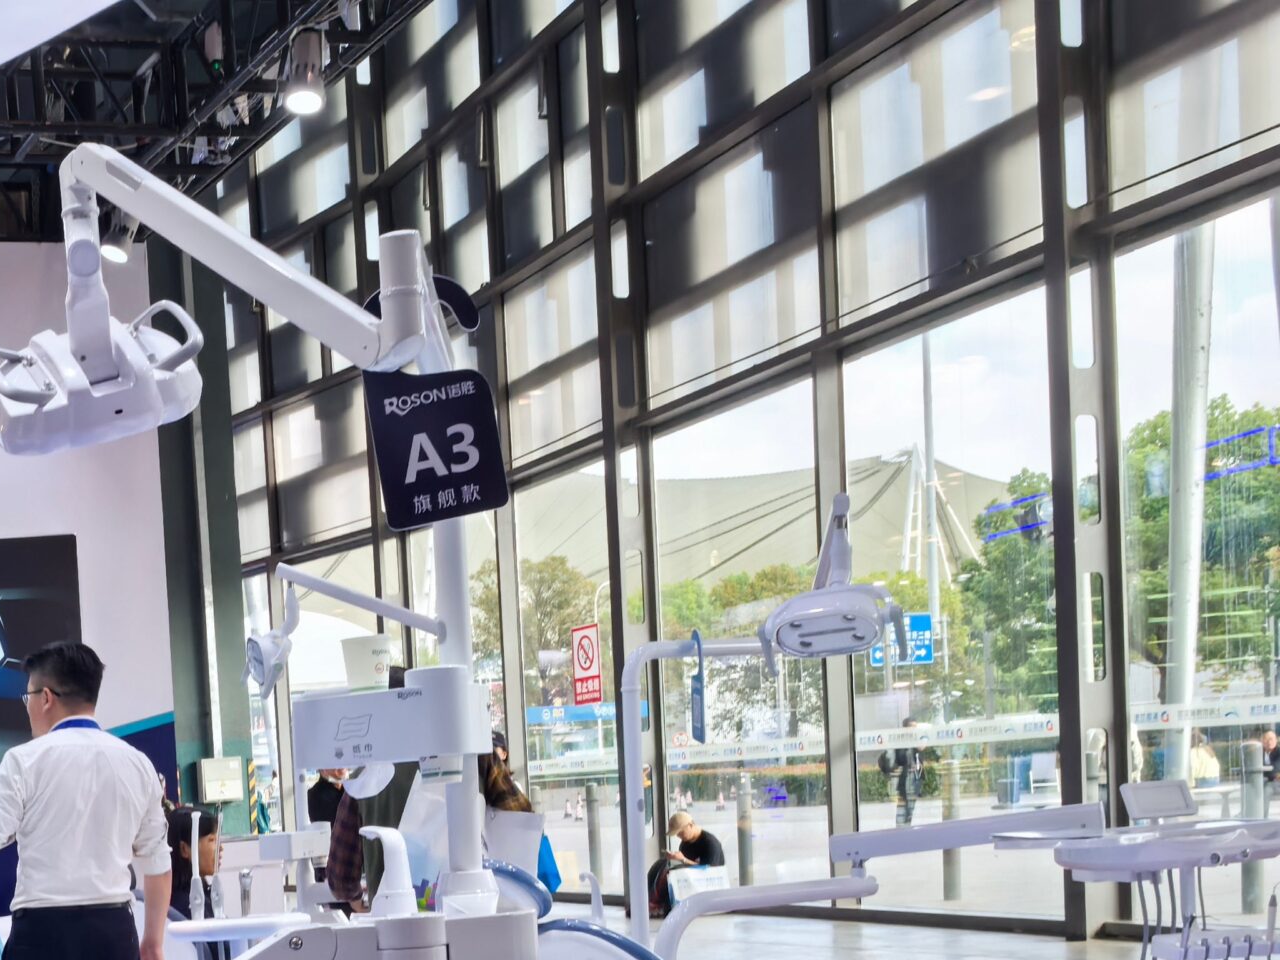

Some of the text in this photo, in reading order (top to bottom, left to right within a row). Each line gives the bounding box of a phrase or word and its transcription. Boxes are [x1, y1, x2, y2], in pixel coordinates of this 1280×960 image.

[404, 423, 480, 485] A3
[413, 483, 481, 515] 旗舰款
